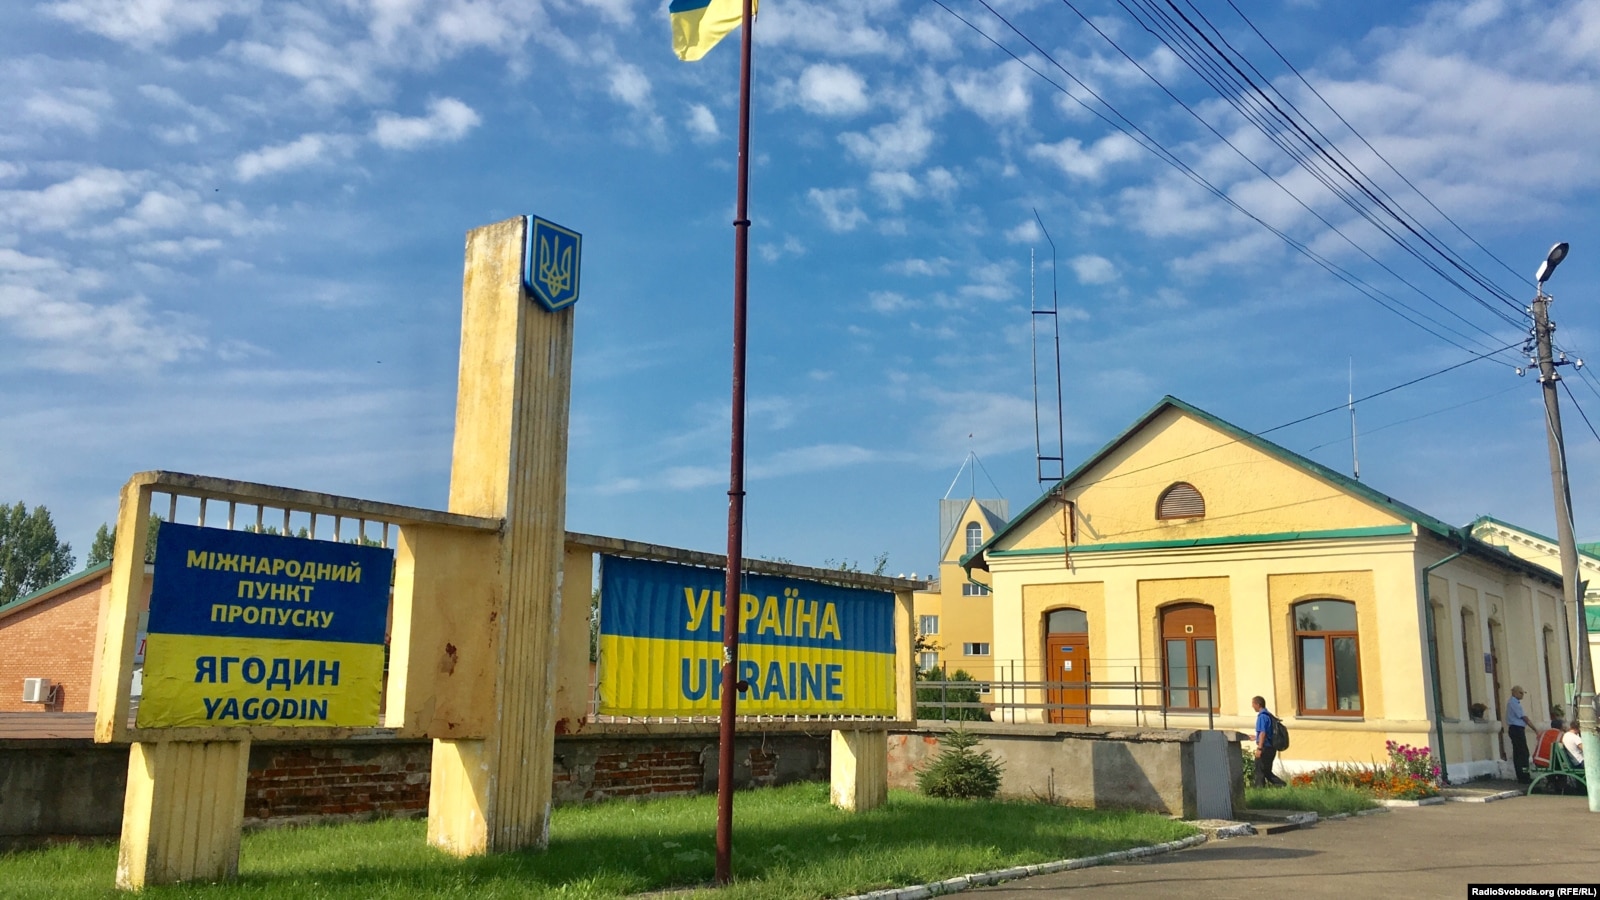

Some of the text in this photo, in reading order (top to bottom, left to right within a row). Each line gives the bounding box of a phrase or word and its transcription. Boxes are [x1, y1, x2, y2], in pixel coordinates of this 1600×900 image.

[186, 549, 361, 583] МІЖНАРОДНИЙ
[237, 580, 314, 602] ПУНКТ
[211, 604, 334, 628] ПРОПУСКУ
[194, 656, 340, 691] ЯГОДИН
[203, 697, 328, 720] YAGODIN
